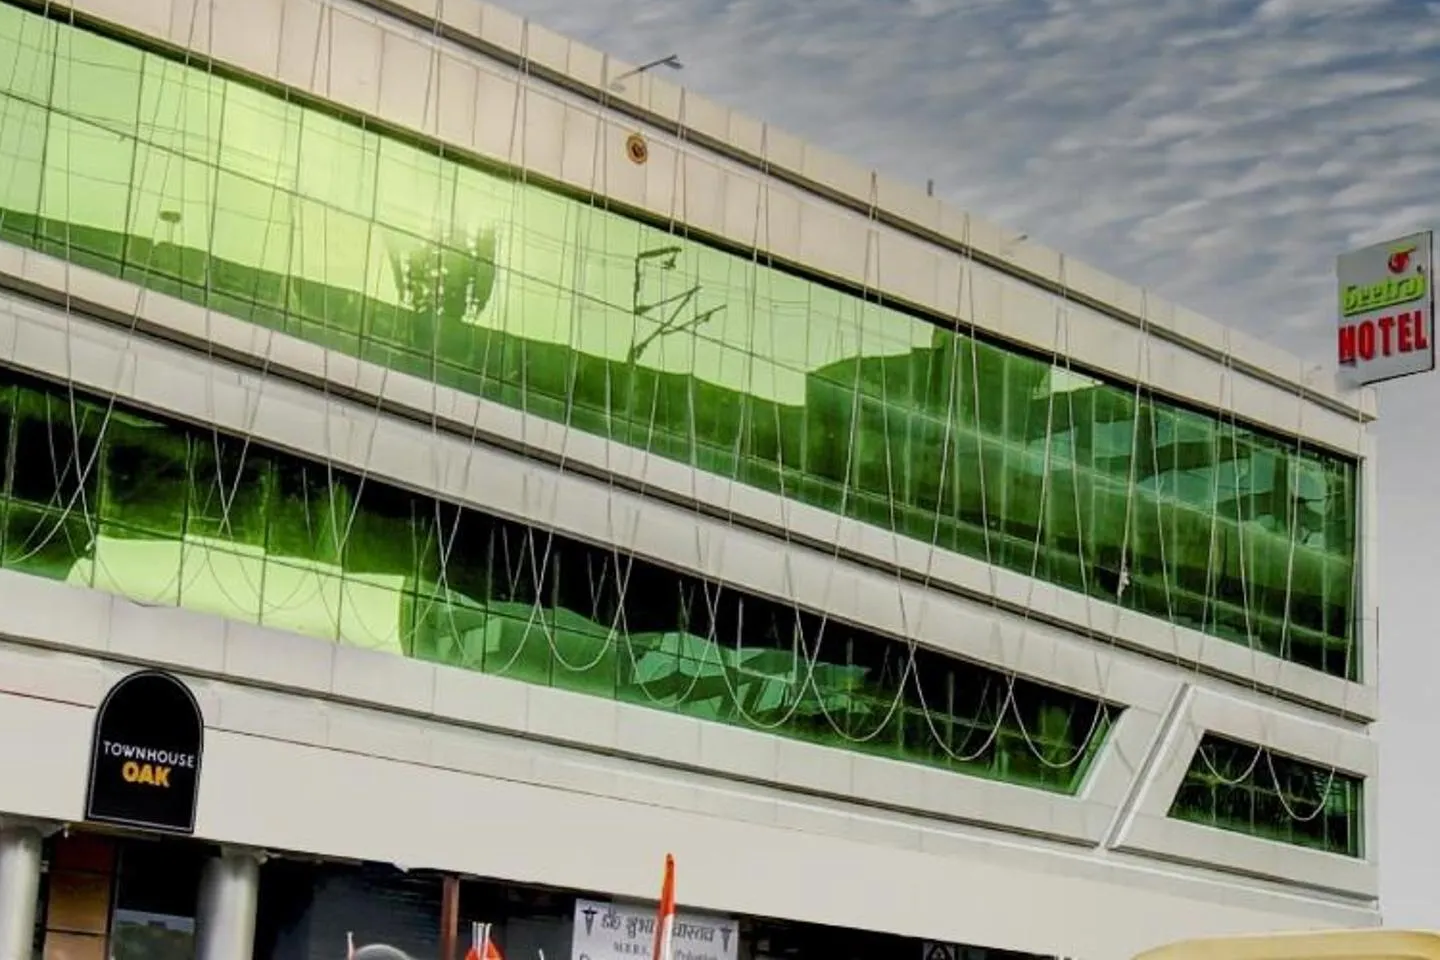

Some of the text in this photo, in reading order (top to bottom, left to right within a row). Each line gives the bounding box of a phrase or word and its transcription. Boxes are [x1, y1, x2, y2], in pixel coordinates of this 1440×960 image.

[1338, 310, 1429, 367] HOTEL
[103, 740, 195, 768] TOWNHOUSE
[122, 761, 172, 788] OAK
